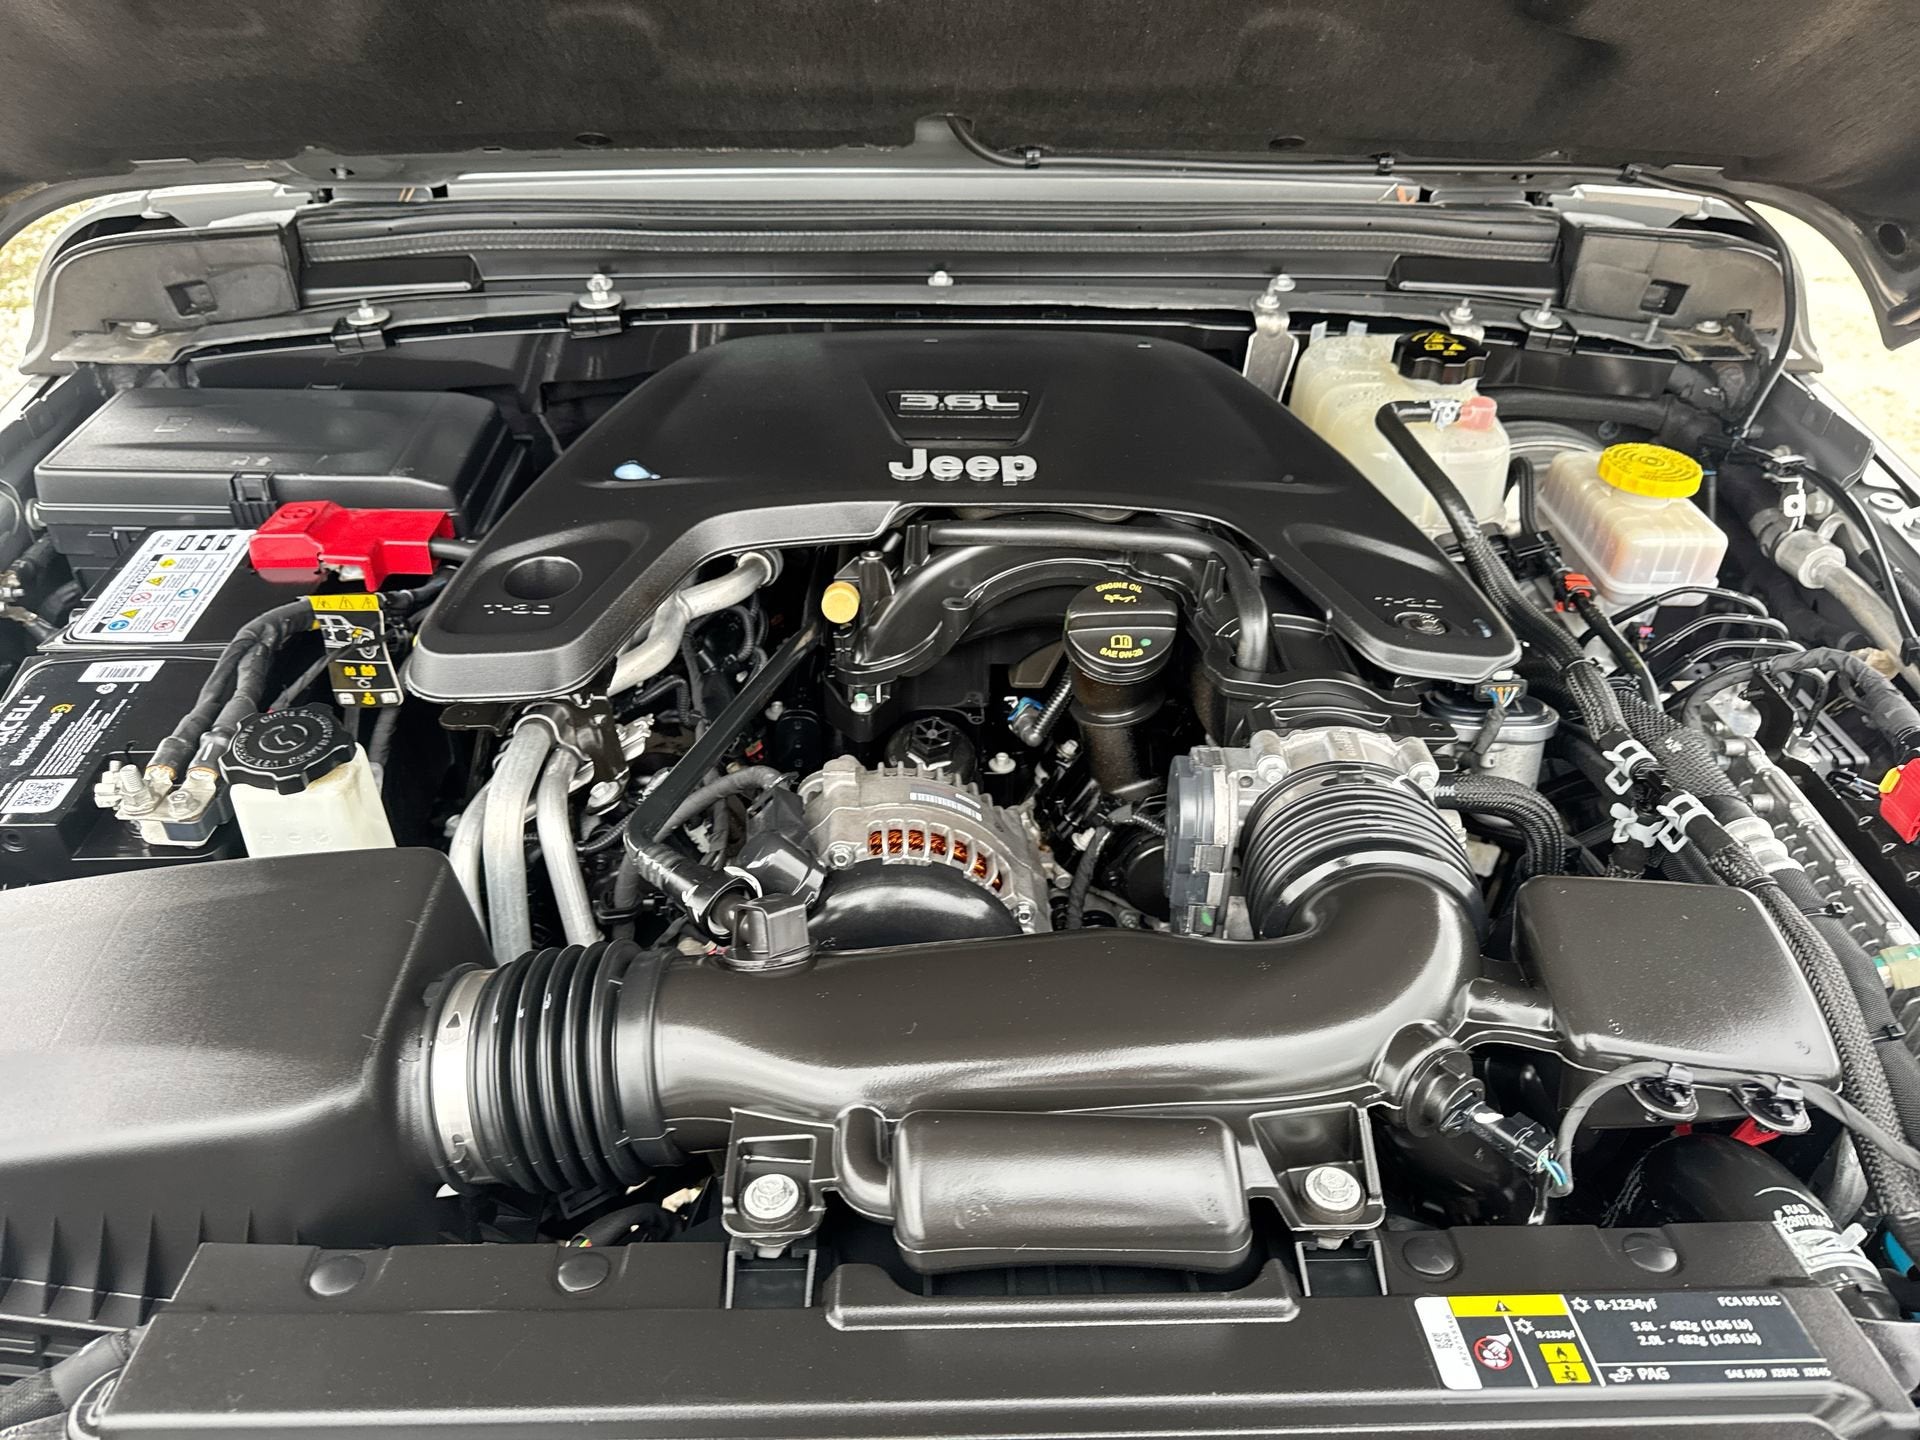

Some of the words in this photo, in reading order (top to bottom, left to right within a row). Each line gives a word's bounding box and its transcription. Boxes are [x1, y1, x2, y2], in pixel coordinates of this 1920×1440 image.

[900, 394, 1019, 411] 3.6L
[888, 448, 1038, 486] Jeep
[1095, 582, 1129, 592] ENGINE
[1129, 583, 1143, 593] OIL
[1099, 647, 1118, 658] SAE
[1595, 1298, 1658, 1312] R-1234yf
[1717, 1296, 1742, 1307] FCA
[1743, 1296, 1761, 1306] US
[1761, 1295, 1782, 1306] LLC
[1629, 1321, 1658, 1332] 3.6L
[1637, 1335, 1666, 1346] 2.0L
[1637, 1367, 1671, 1381] PAG
